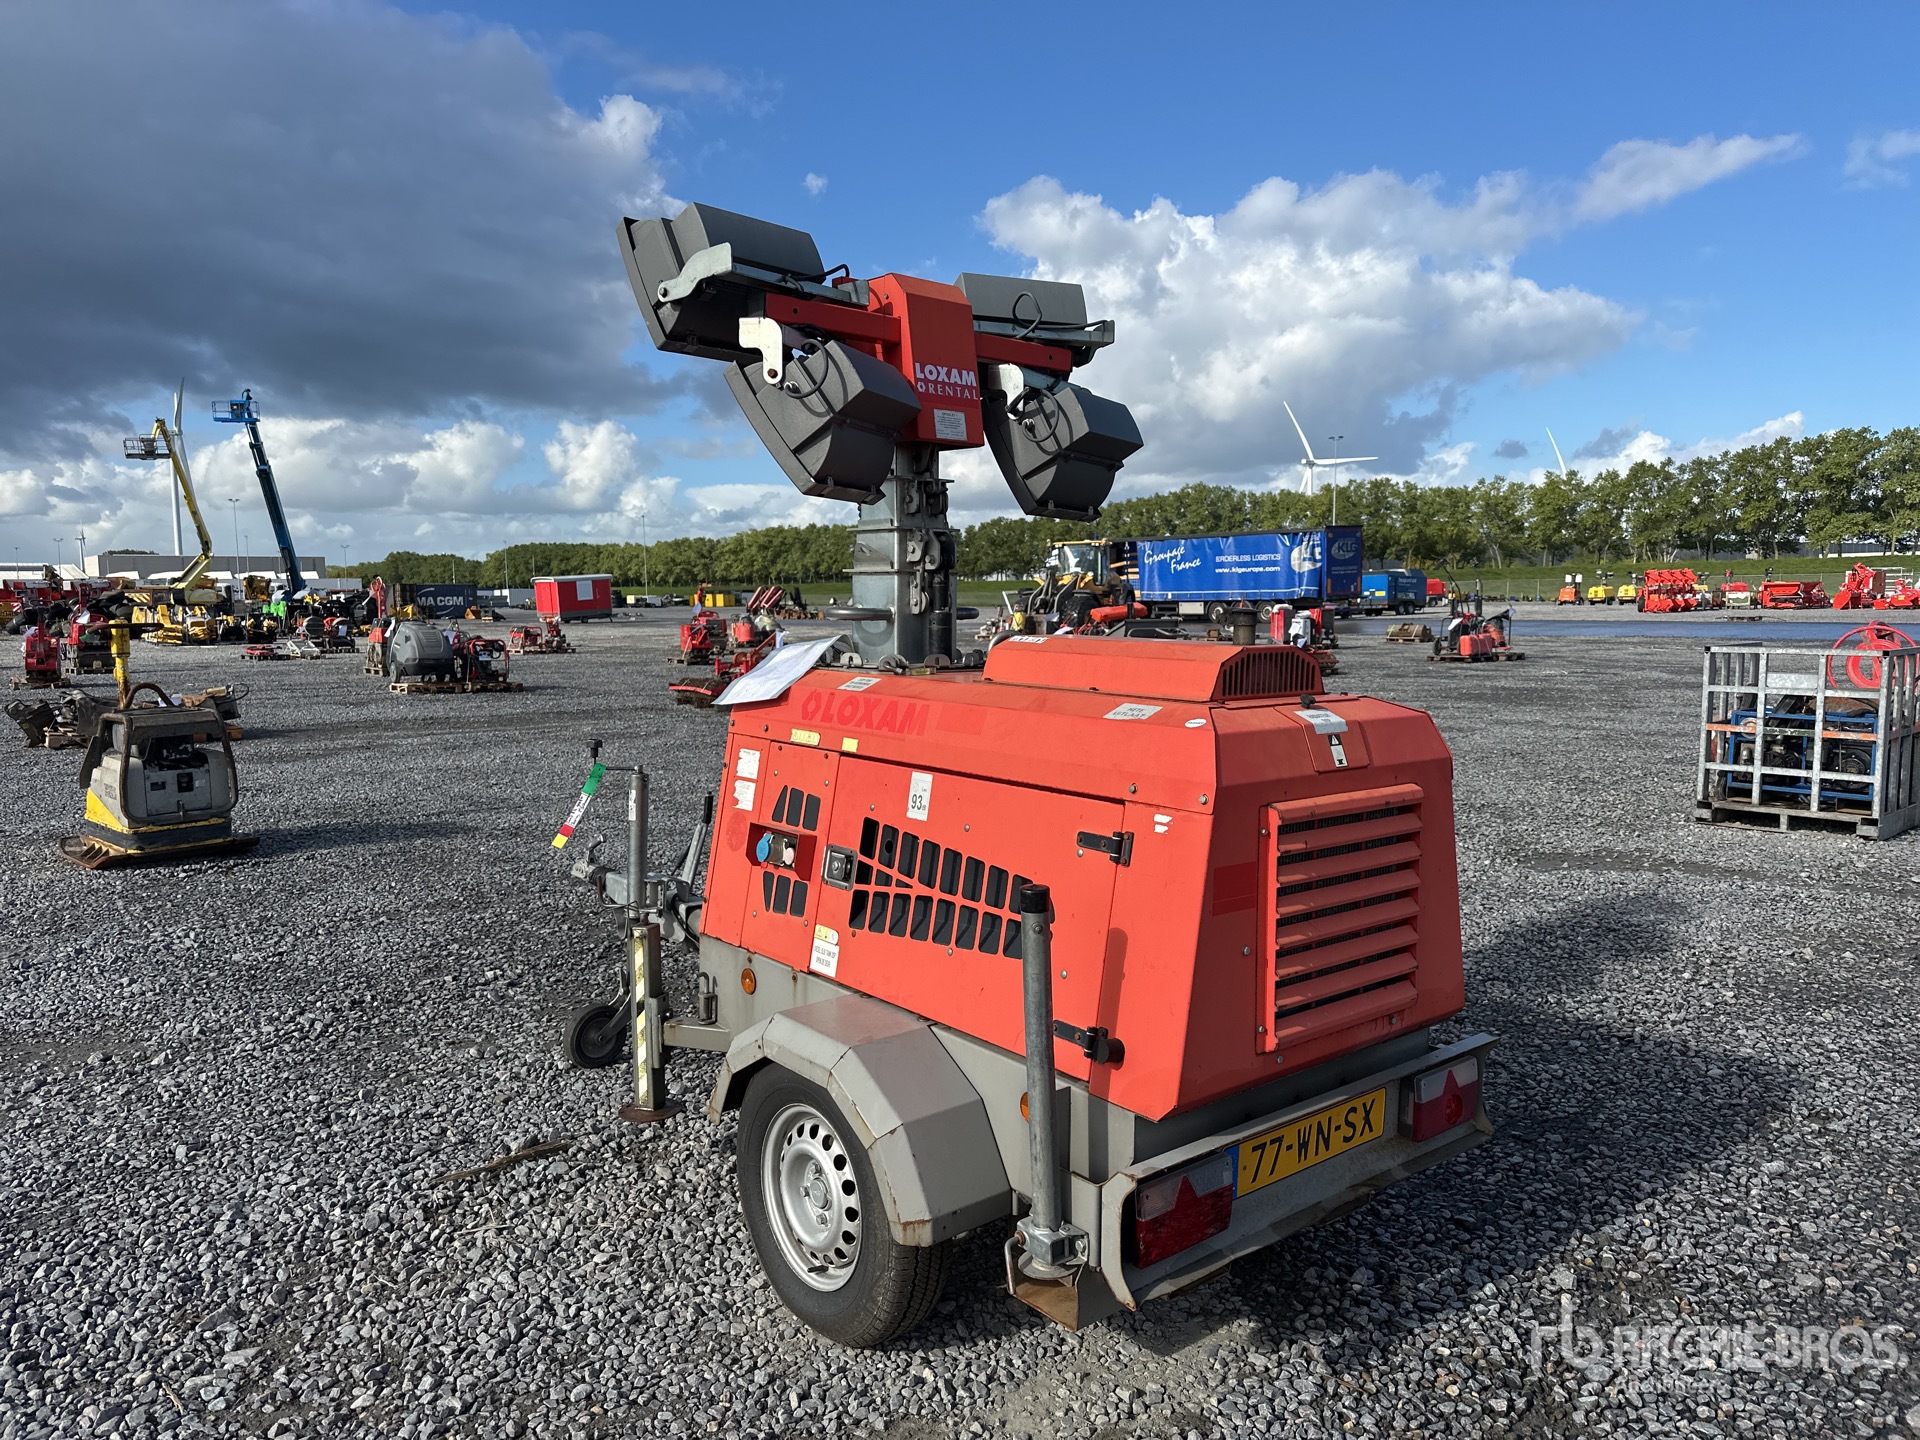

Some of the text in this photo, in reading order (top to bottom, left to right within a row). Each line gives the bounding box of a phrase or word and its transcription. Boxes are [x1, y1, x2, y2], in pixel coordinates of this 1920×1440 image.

[914, 362, 977, 387] LOXAM
[928, 382, 979, 400] RENTAL
[1144, 545, 1186, 565] Groupage
[1252, 553, 1281, 561] LOGISTICS
[1170, 557, 1202, 574] France
[436, 596, 464, 606] CGM
[819, 691, 931, 737] LOXAM
[911, 793, 923, 811] 93
[1250, 1098, 1376, 1184] 77-WN-SX
